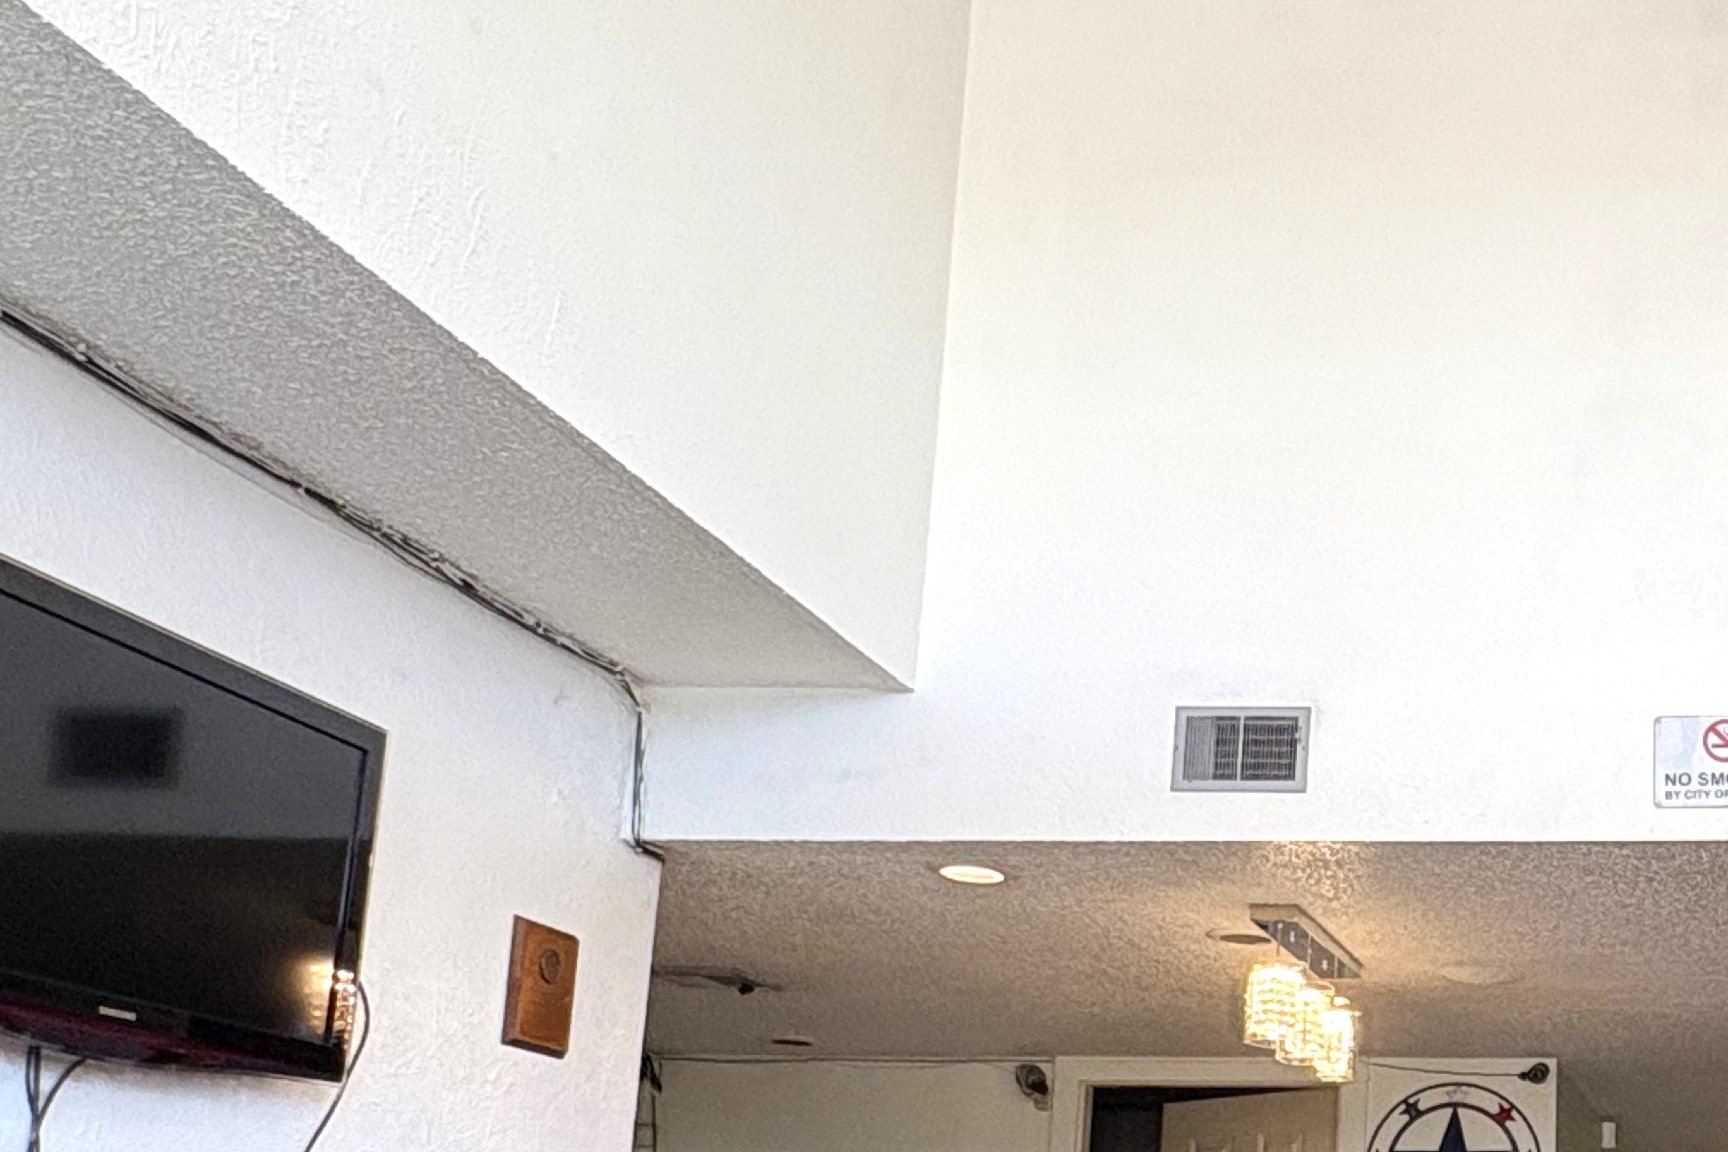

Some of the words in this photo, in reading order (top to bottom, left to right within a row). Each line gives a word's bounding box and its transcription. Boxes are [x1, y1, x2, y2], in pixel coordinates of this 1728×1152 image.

[1664, 772, 1692, 787] NO
[1664, 790, 1681, 800] BY
[1684, 789, 1711, 800] CITY
